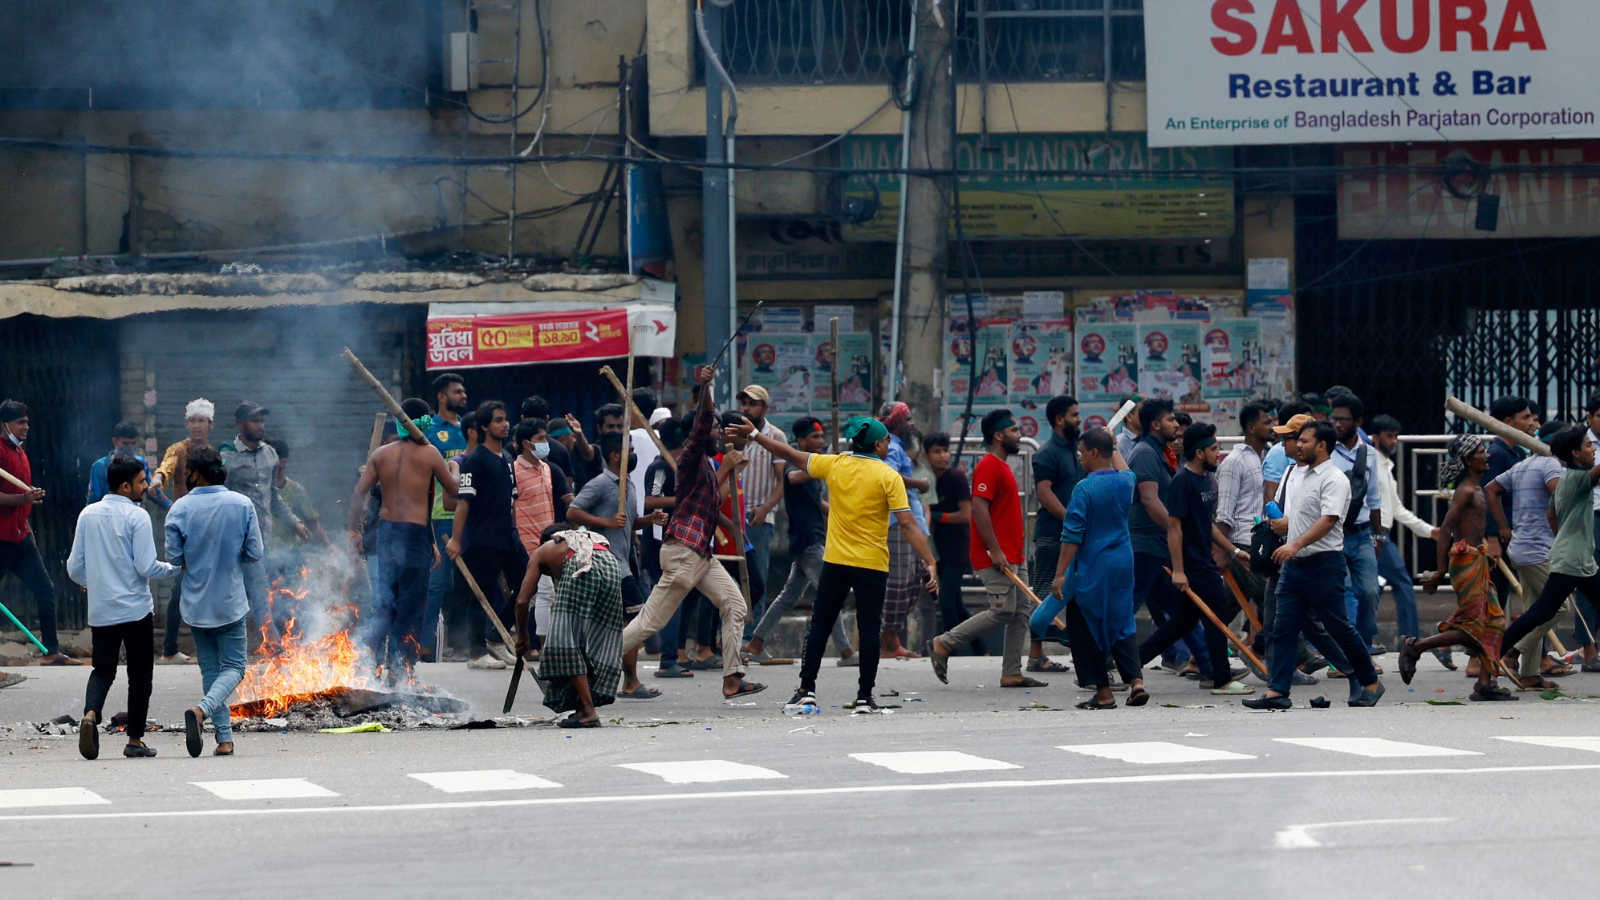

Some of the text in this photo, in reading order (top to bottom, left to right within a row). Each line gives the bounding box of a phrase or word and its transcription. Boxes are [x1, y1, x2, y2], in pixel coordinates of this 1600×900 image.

[1210, 0, 1547, 56] SAKURA
[1229, 70, 1531, 98] Restaurant & Bar
[1165, 107, 1595, 132] An Enterprise of Bangladesh Parjatan Corporation
[428, 328, 473, 349] সুবিধা
[481, 329, 507, 347] ৫০
[544, 331, 578, 344] ১৪.৯০
[585, 320, 600, 342] ২
[428, 346, 474, 362] ডাবল
[460, 472, 473, 487] 36
